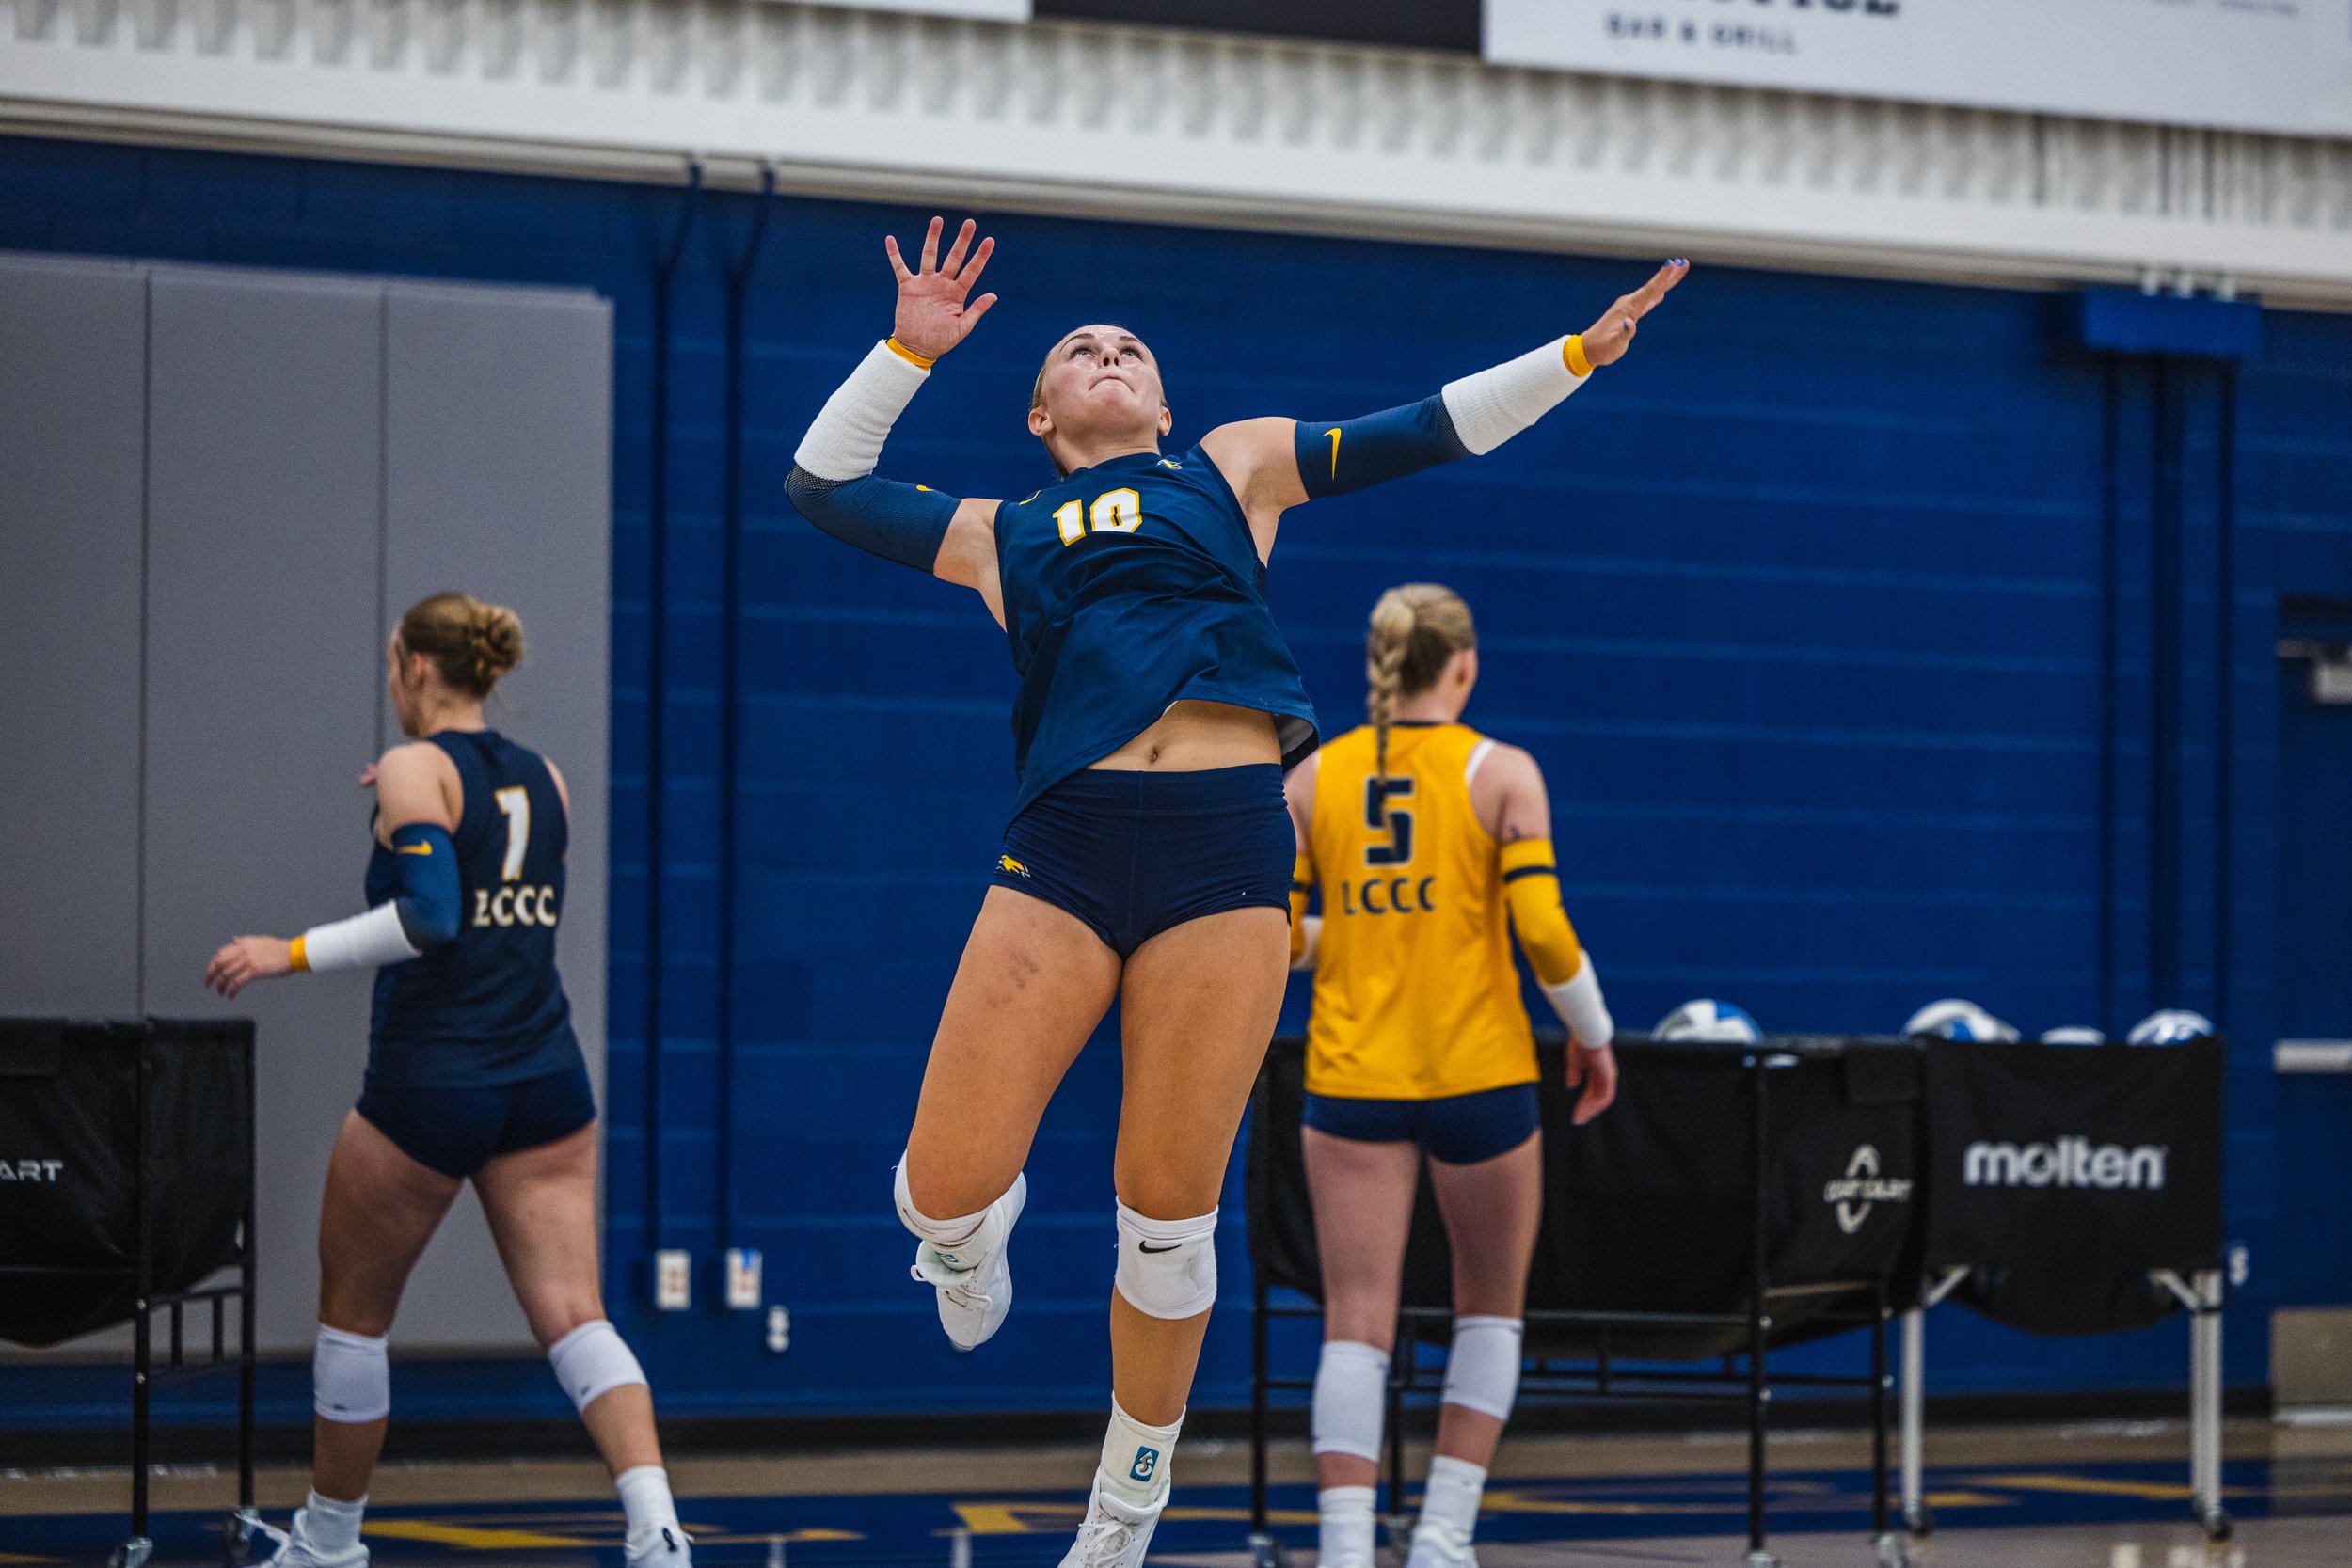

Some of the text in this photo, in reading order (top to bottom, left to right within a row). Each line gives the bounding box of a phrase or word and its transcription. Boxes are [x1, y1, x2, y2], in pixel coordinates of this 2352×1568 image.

[1052, 487, 1143, 547] 10
[493, 784, 532, 882] 1
[1364, 775, 1415, 868] 5
[472, 884, 557, 927] LCCC
[1342, 875, 1436, 916] LCCC
[0, 1158, 64, 1182] ART
[1963, 1134, 2166, 1191] molten
